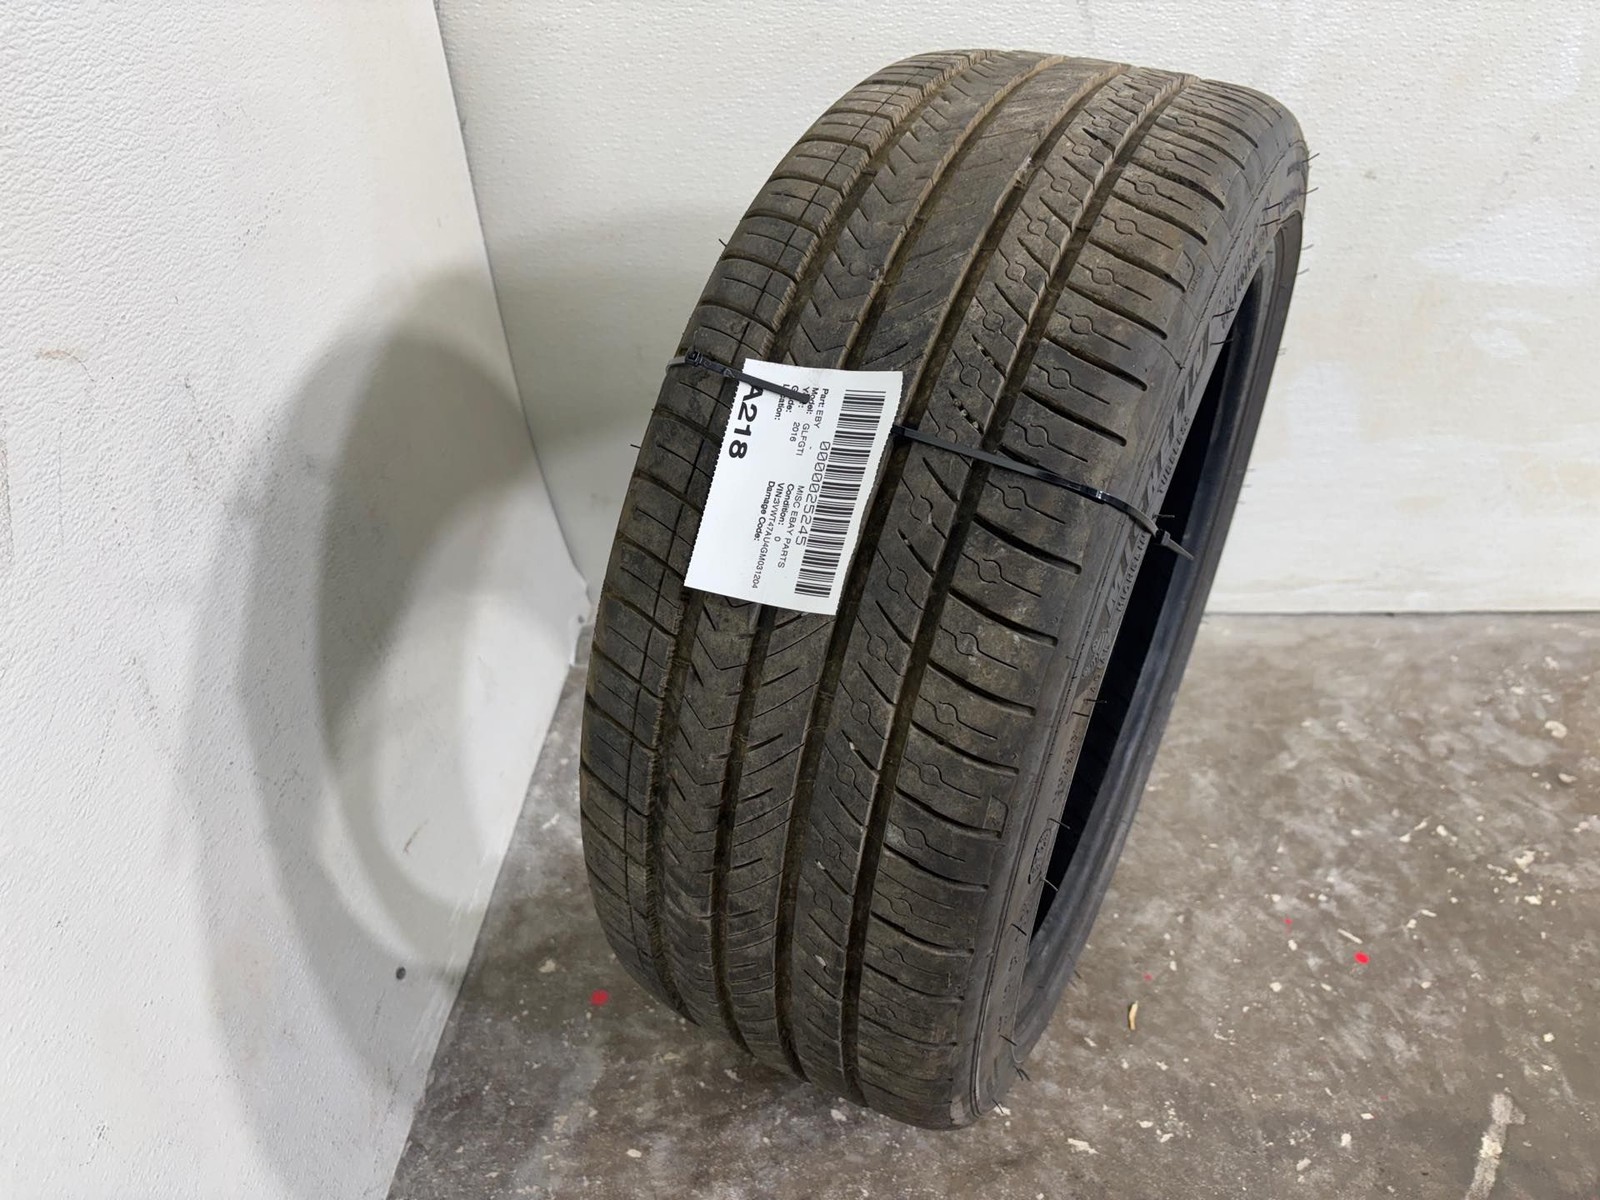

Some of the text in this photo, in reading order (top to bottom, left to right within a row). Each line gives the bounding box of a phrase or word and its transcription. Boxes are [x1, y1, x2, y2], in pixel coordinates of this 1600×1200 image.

[774, 385, 788, 420] Lcation:
[786, 385, 799, 413] Gde:
[806, 387, 819, 414] Model:
[818, 388, 829, 408] Part:
[729, 384, 763, 459] A218
[789, 421, 800, 442] 2016
[814, 410, 824, 429] EBY
[796, 423, 810, 456] GLFGTI
[778, 483, 795, 525] Condition:
[795, 441, 830, 546] 0000025245
[754, 481, 776, 541] Damage Code:
[777, 485, 805, 568] MISC EBAY PARTS
